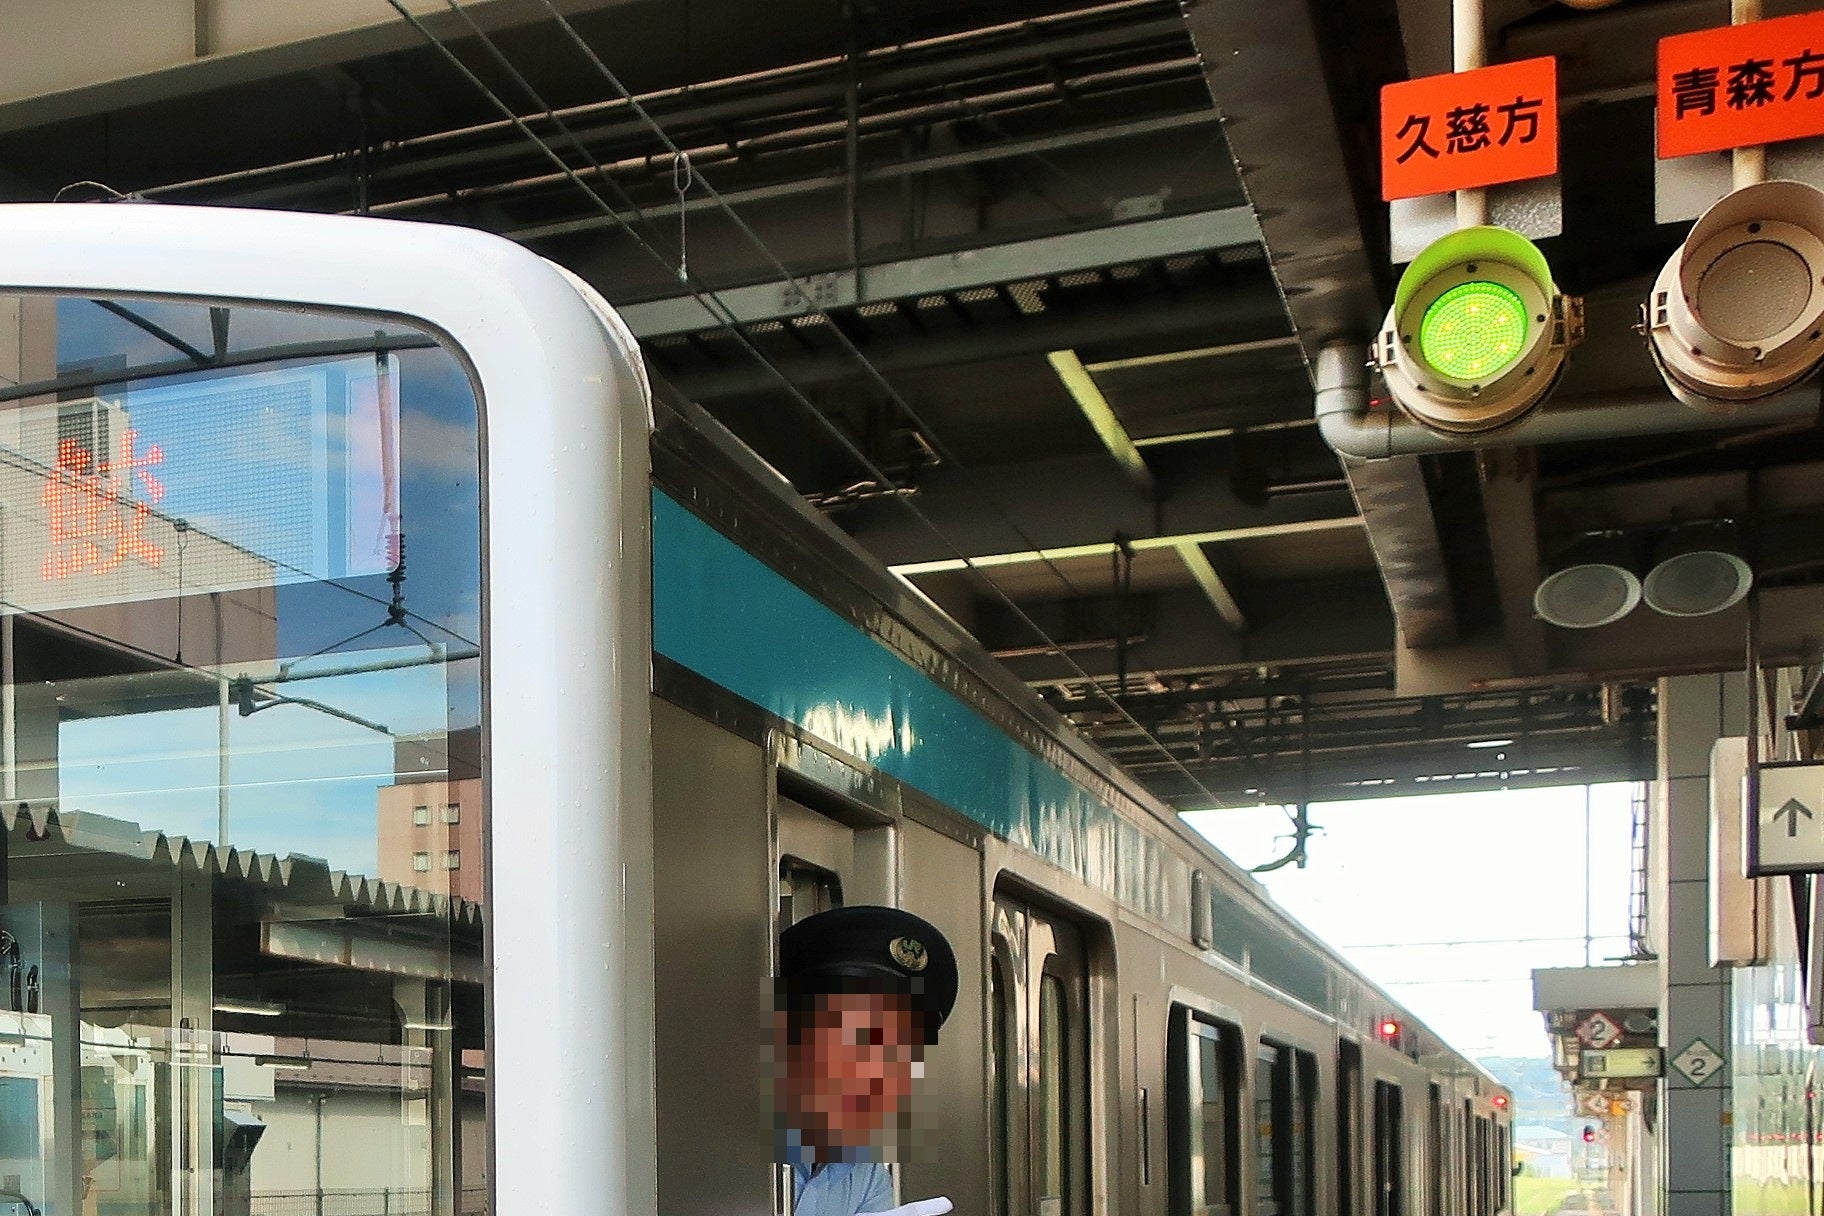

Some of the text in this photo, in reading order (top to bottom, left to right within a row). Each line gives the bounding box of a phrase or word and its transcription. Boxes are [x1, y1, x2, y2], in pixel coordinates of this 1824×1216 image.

[1670, 47, 1824, 120] 青森方
[1394, 94, 1545, 166] 久慈方
[1590, 1020, 1606, 1041] 2
[1690, 1057, 1707, 1076] 2
